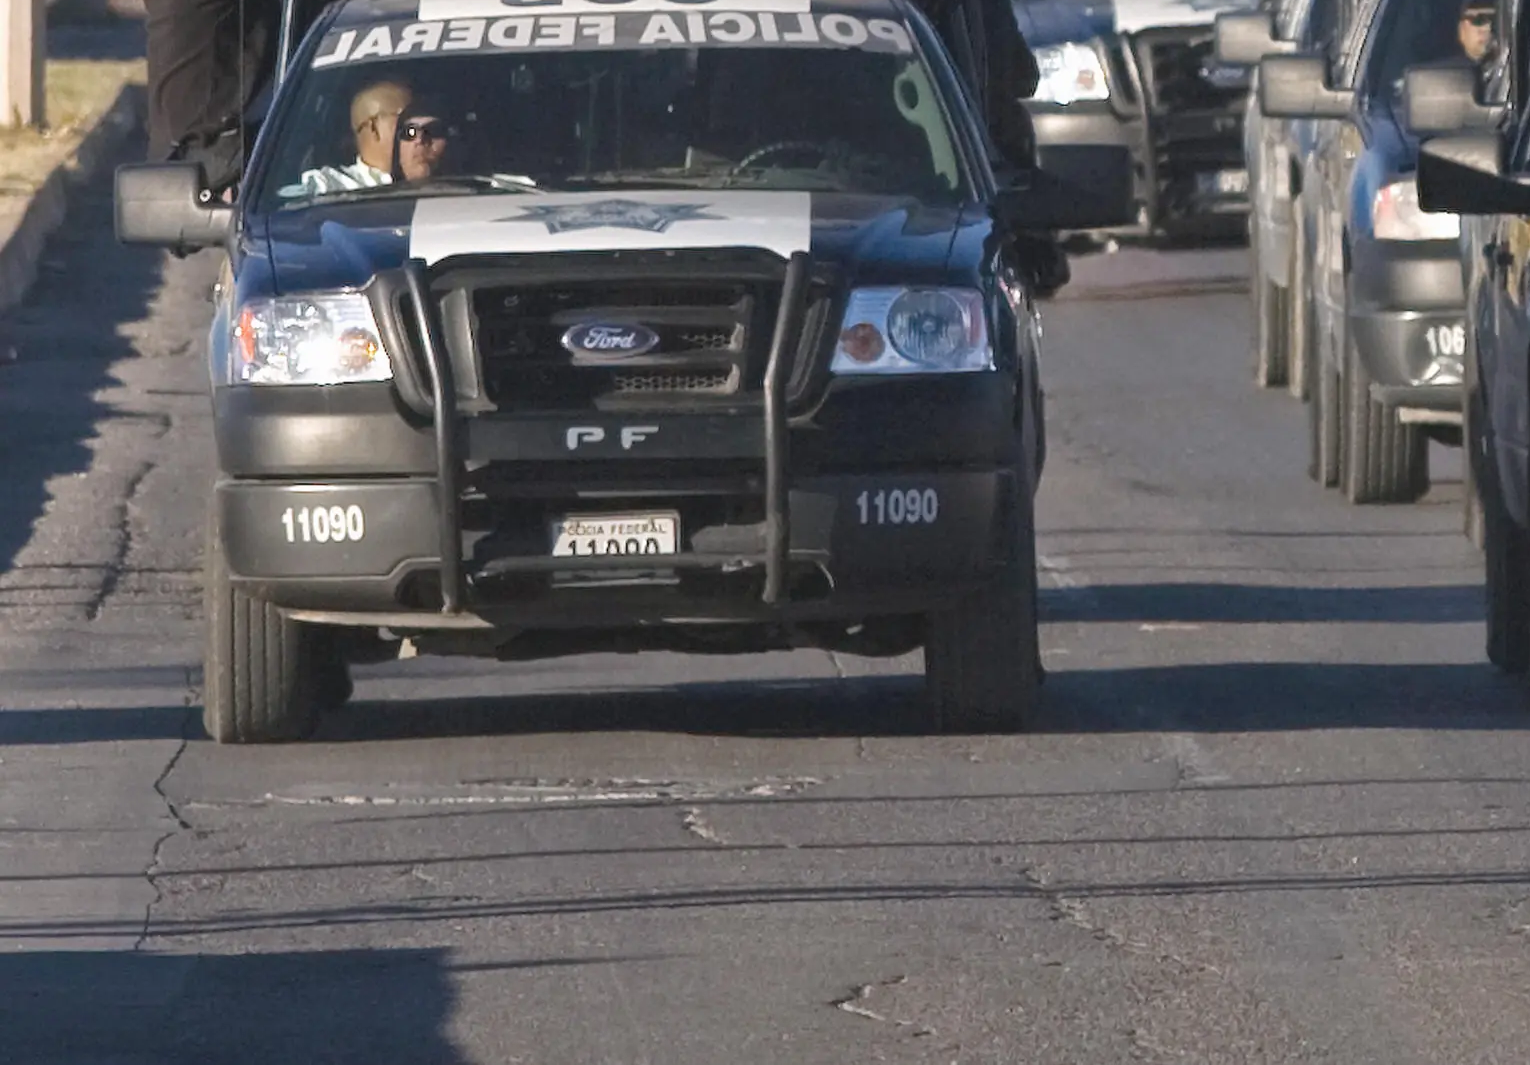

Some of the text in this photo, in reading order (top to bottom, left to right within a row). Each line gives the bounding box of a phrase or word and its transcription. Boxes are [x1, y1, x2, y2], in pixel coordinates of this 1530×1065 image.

[583, 326, 637, 349] Ford
[282, 504, 364, 543] 11090
[857, 488, 939, 525] 11090
